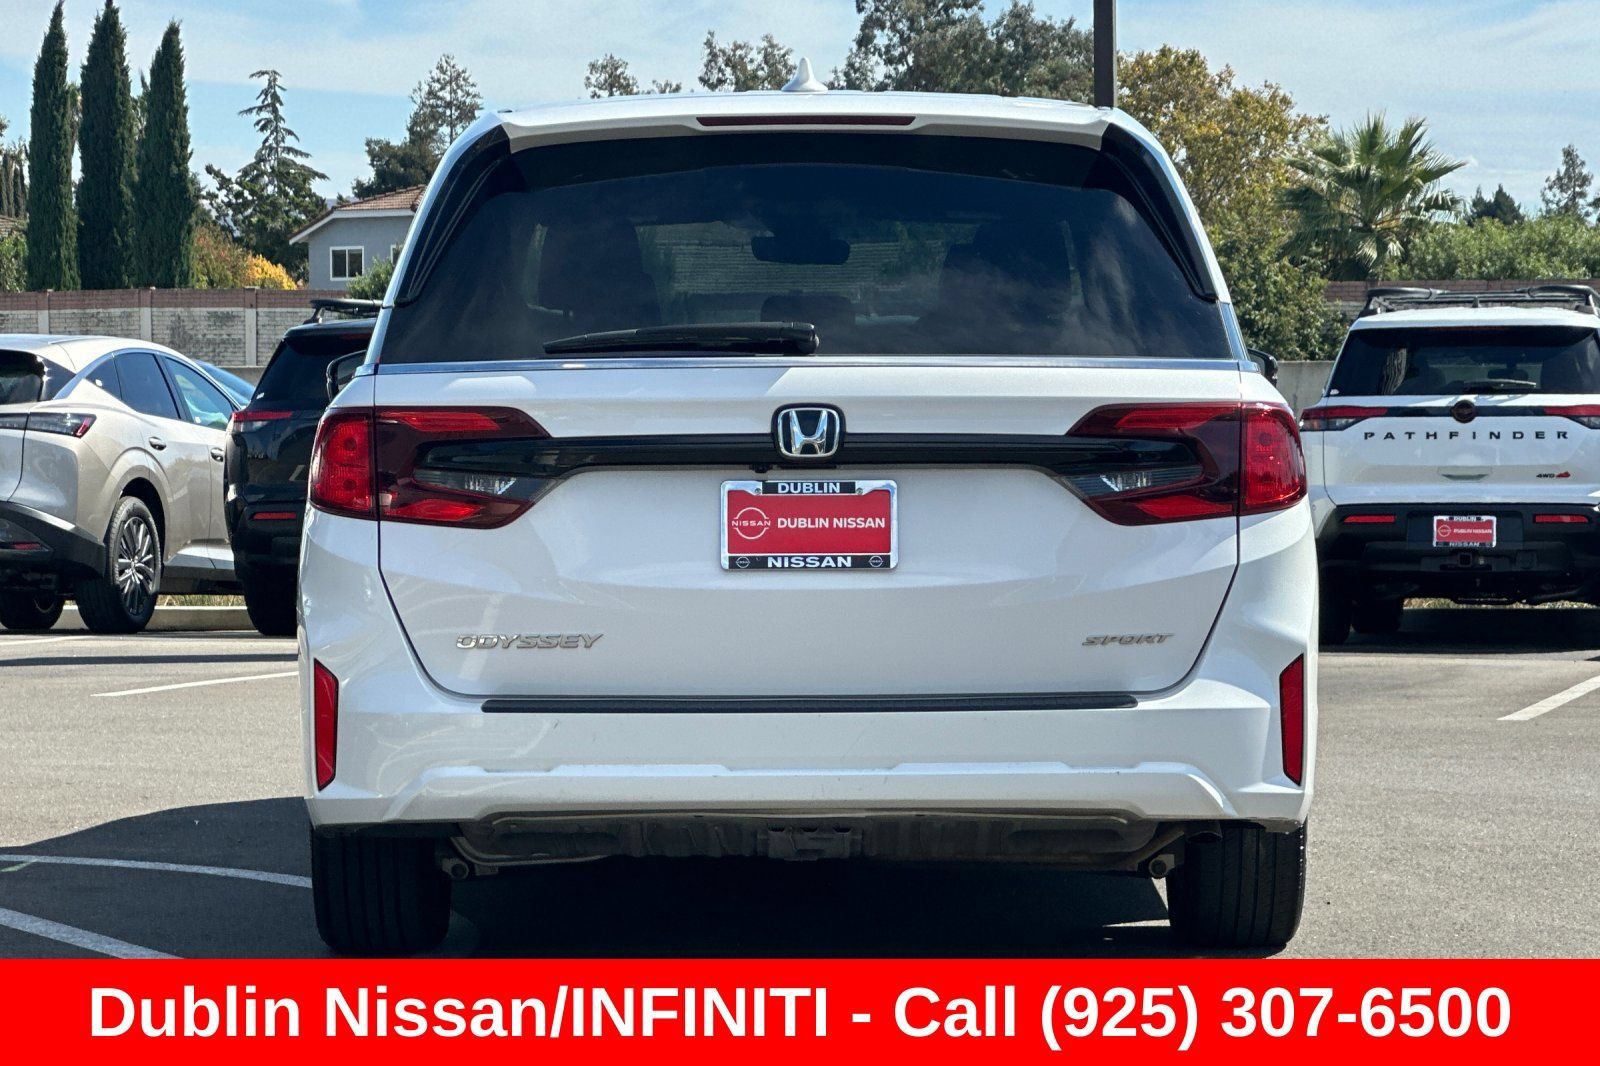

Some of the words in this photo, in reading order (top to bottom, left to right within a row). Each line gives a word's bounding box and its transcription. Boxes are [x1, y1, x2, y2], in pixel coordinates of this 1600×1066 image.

[1363, 431, 1569, 440] PATHFINDER
[777, 482, 841, 494] DUBLIN
[777, 517, 830, 529] DUBLIN
[833, 517, 886, 529] NISSAN
[767, 556, 852, 568] NISSAN
[456, 633, 604, 649] ODYSSEY
[1082, 633, 1176, 646] SPORT
